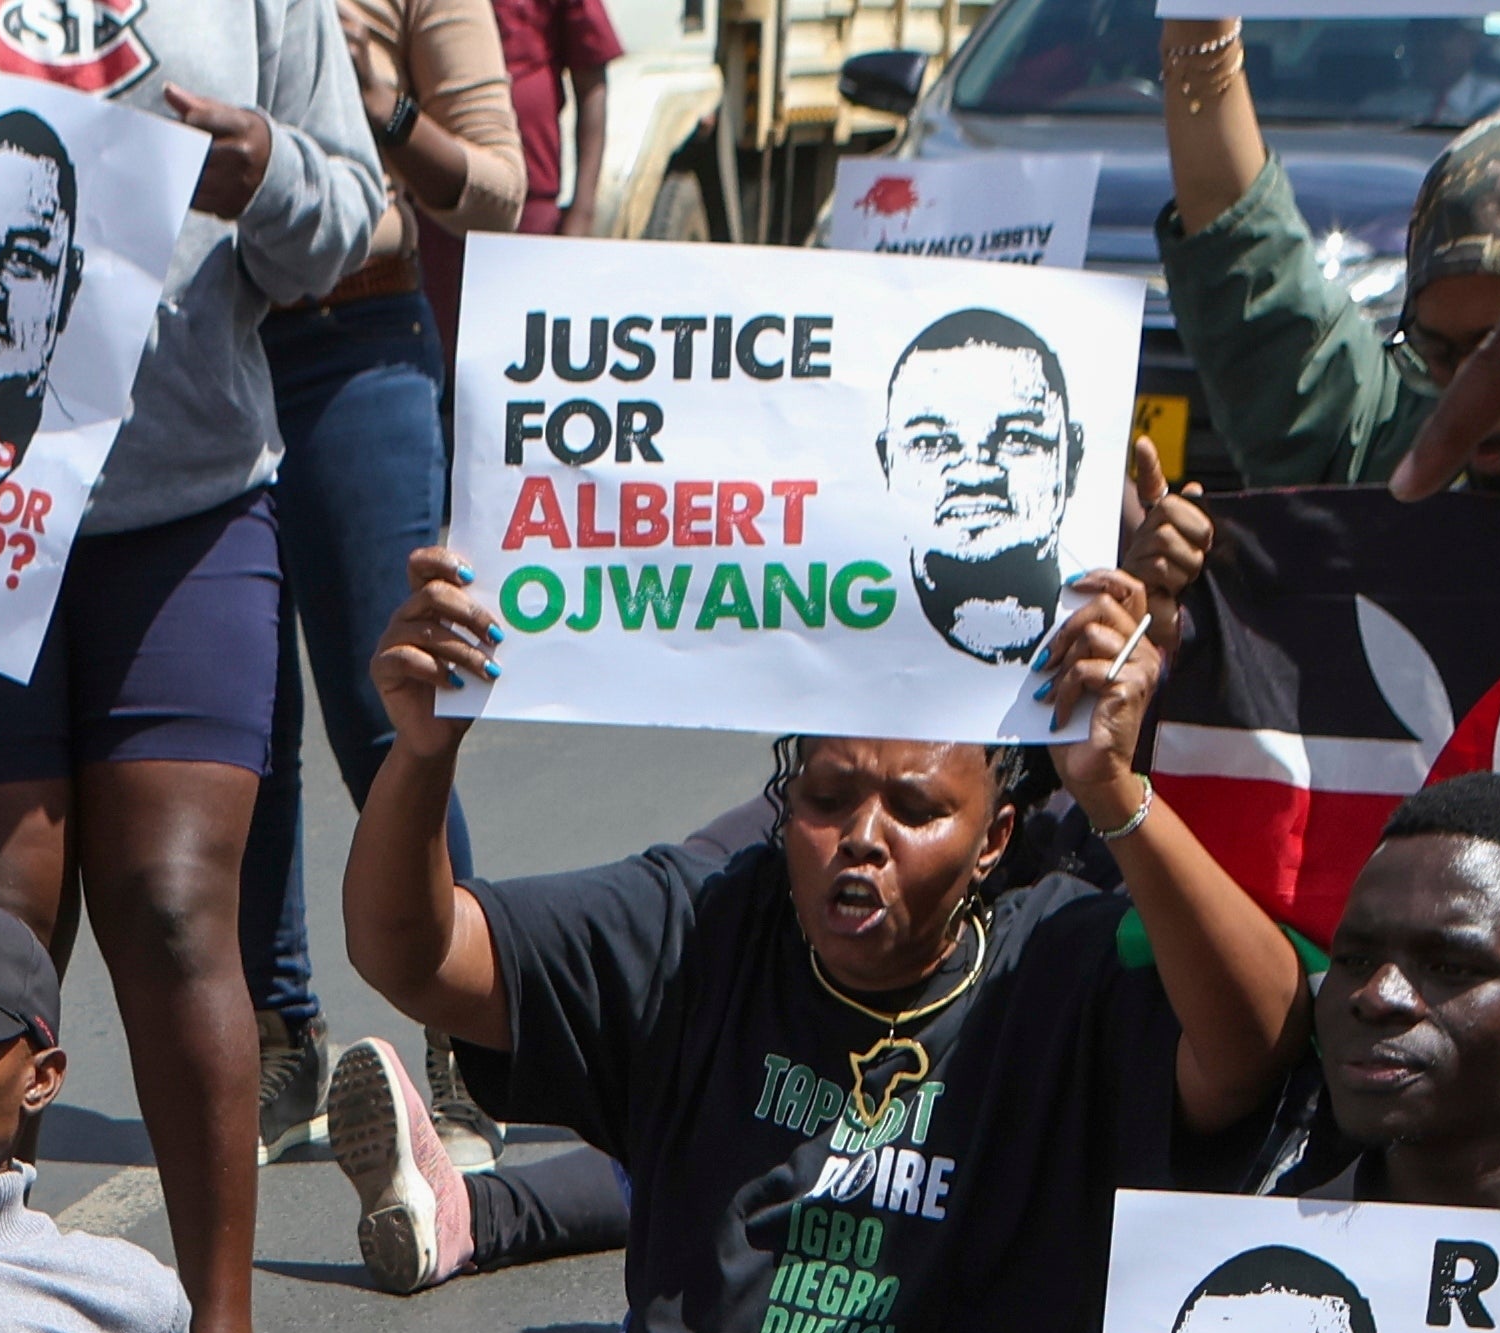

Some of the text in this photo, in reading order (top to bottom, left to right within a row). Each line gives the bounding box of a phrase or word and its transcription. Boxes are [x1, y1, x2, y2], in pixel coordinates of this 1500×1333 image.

[503, 311, 834, 385] JUSTICE
[503, 399, 665, 467] FOR
[500, 475, 819, 552] ALBERT
[498, 559, 897, 633] OJWANG
[787, 1202, 884, 1269] IGBO
[769, 1253, 901, 1322] NEGRA
